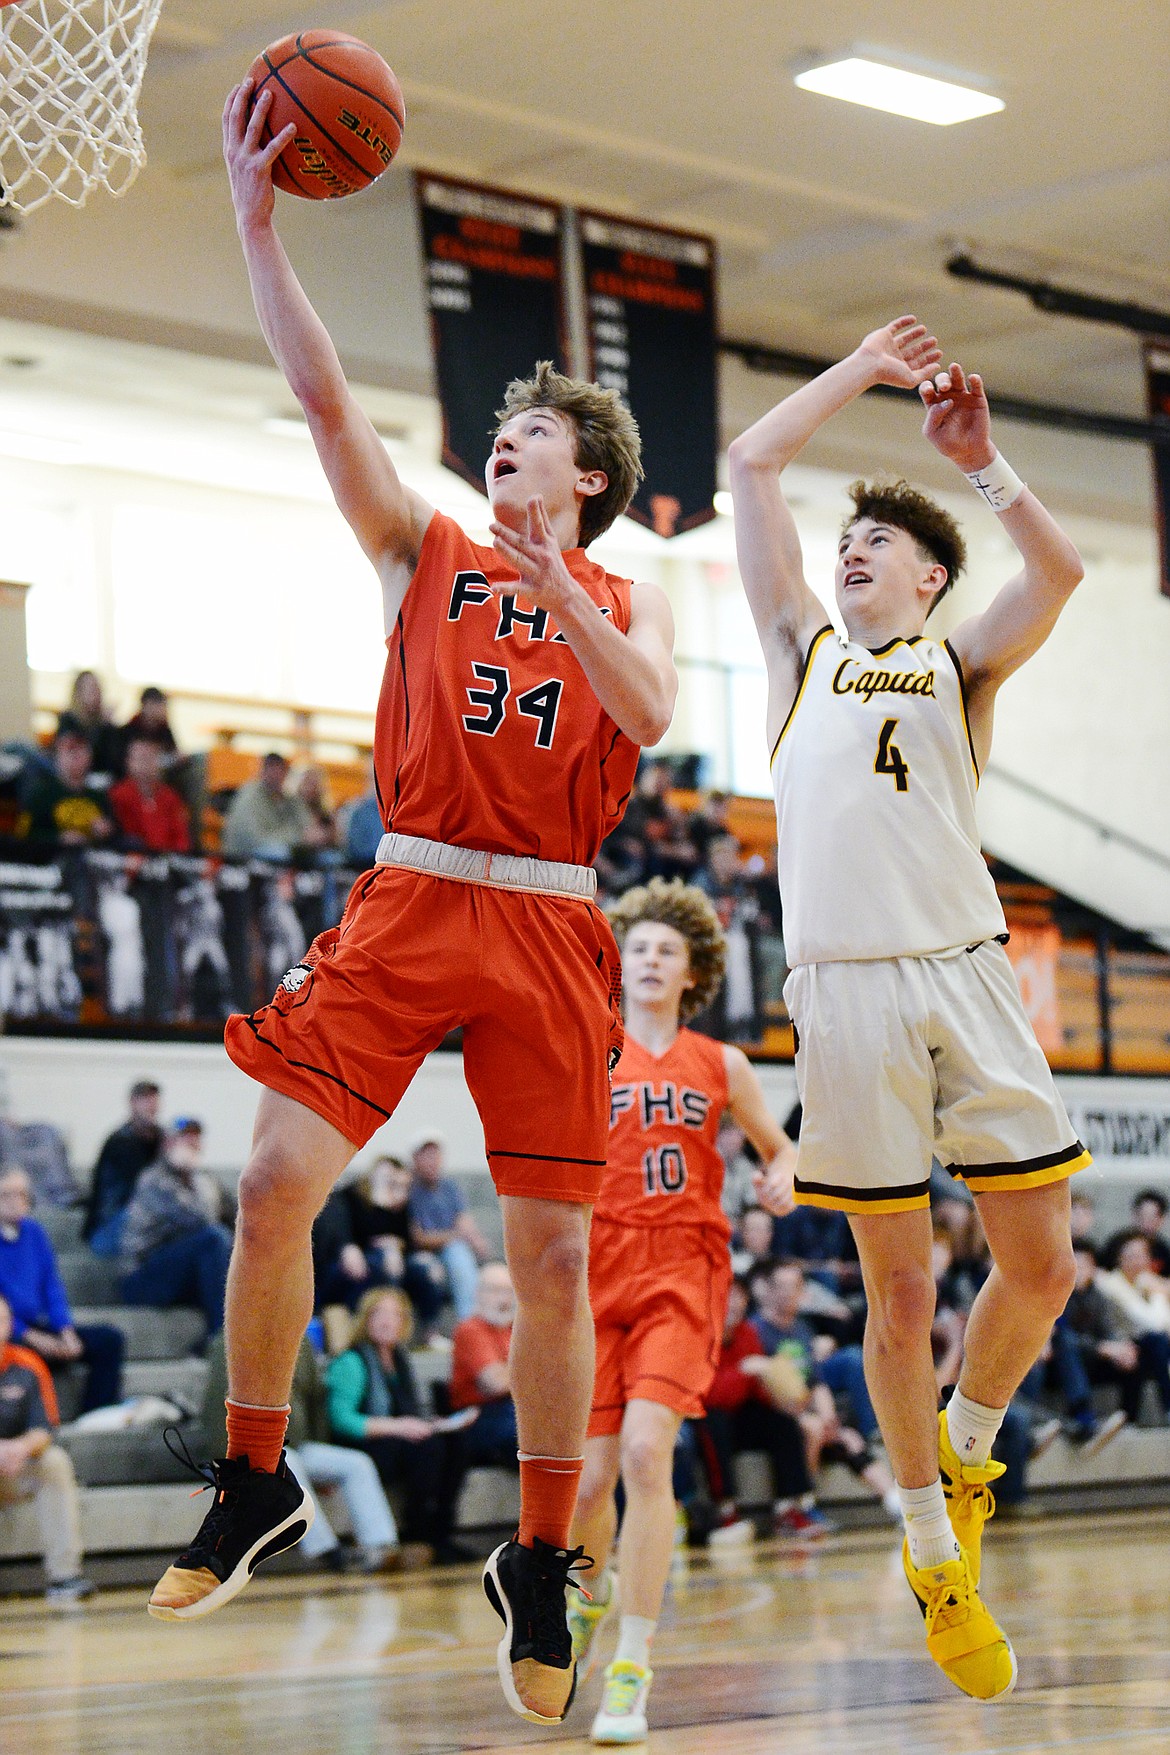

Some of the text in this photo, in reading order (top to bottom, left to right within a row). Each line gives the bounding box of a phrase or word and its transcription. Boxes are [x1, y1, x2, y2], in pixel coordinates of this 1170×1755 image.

[336, 108, 394, 166] ELITE
[462, 661, 564, 750] 34
[873, 717, 911, 792] 4
[609, 1081, 712, 1131] FHS
[642, 1142, 688, 1197] 10
